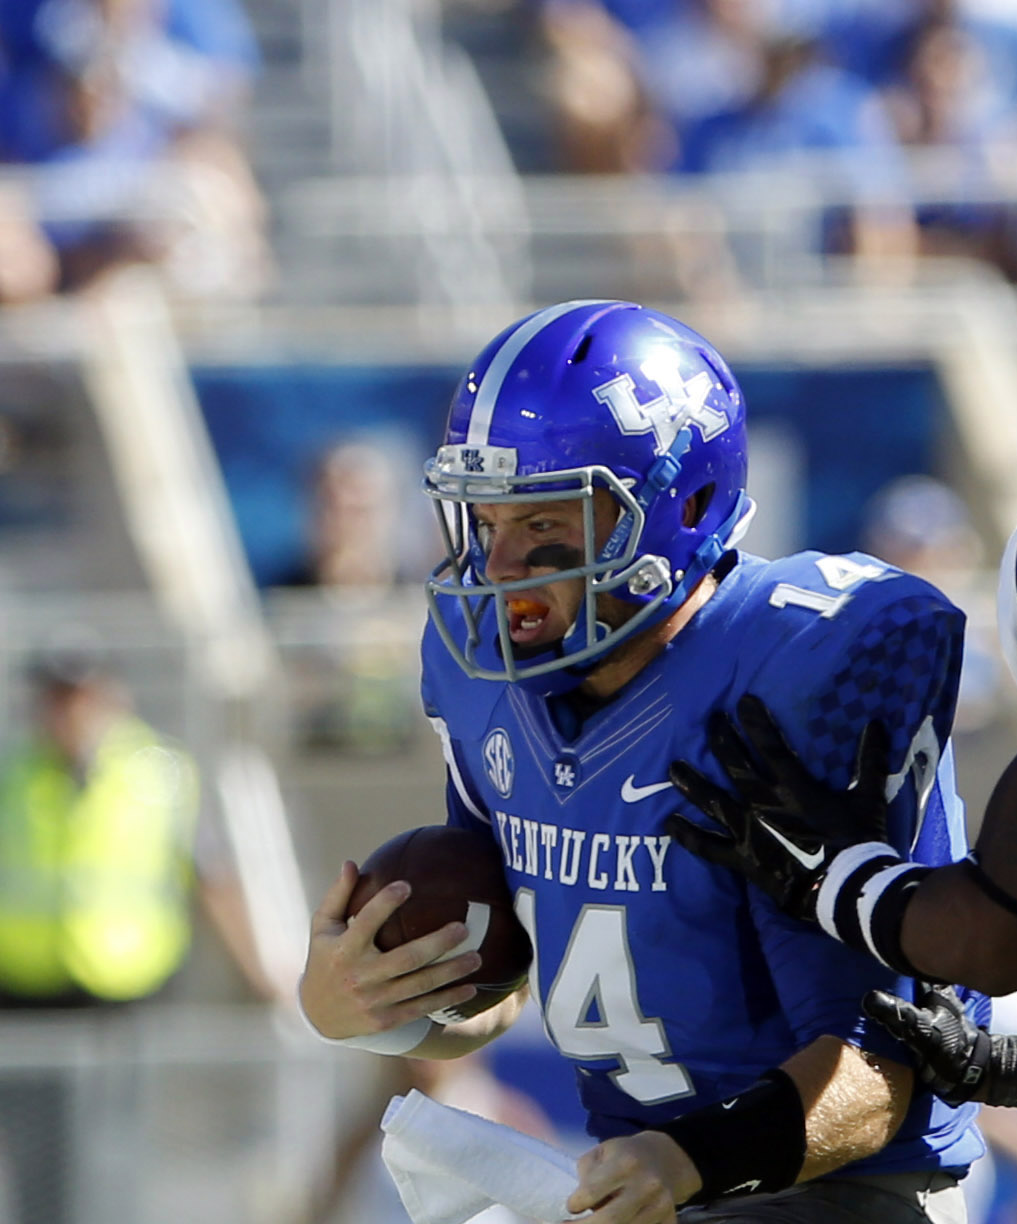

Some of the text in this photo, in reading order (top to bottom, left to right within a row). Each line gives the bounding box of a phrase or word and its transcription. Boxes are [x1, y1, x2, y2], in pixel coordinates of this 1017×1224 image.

[592, 344, 730, 456] UK
[769, 555, 904, 620] 14
[485, 732, 513, 794] SEC
[555, 762, 576, 788] UK
[495, 811, 672, 892] KENTUCKY
[514, 886, 697, 1106] 14
